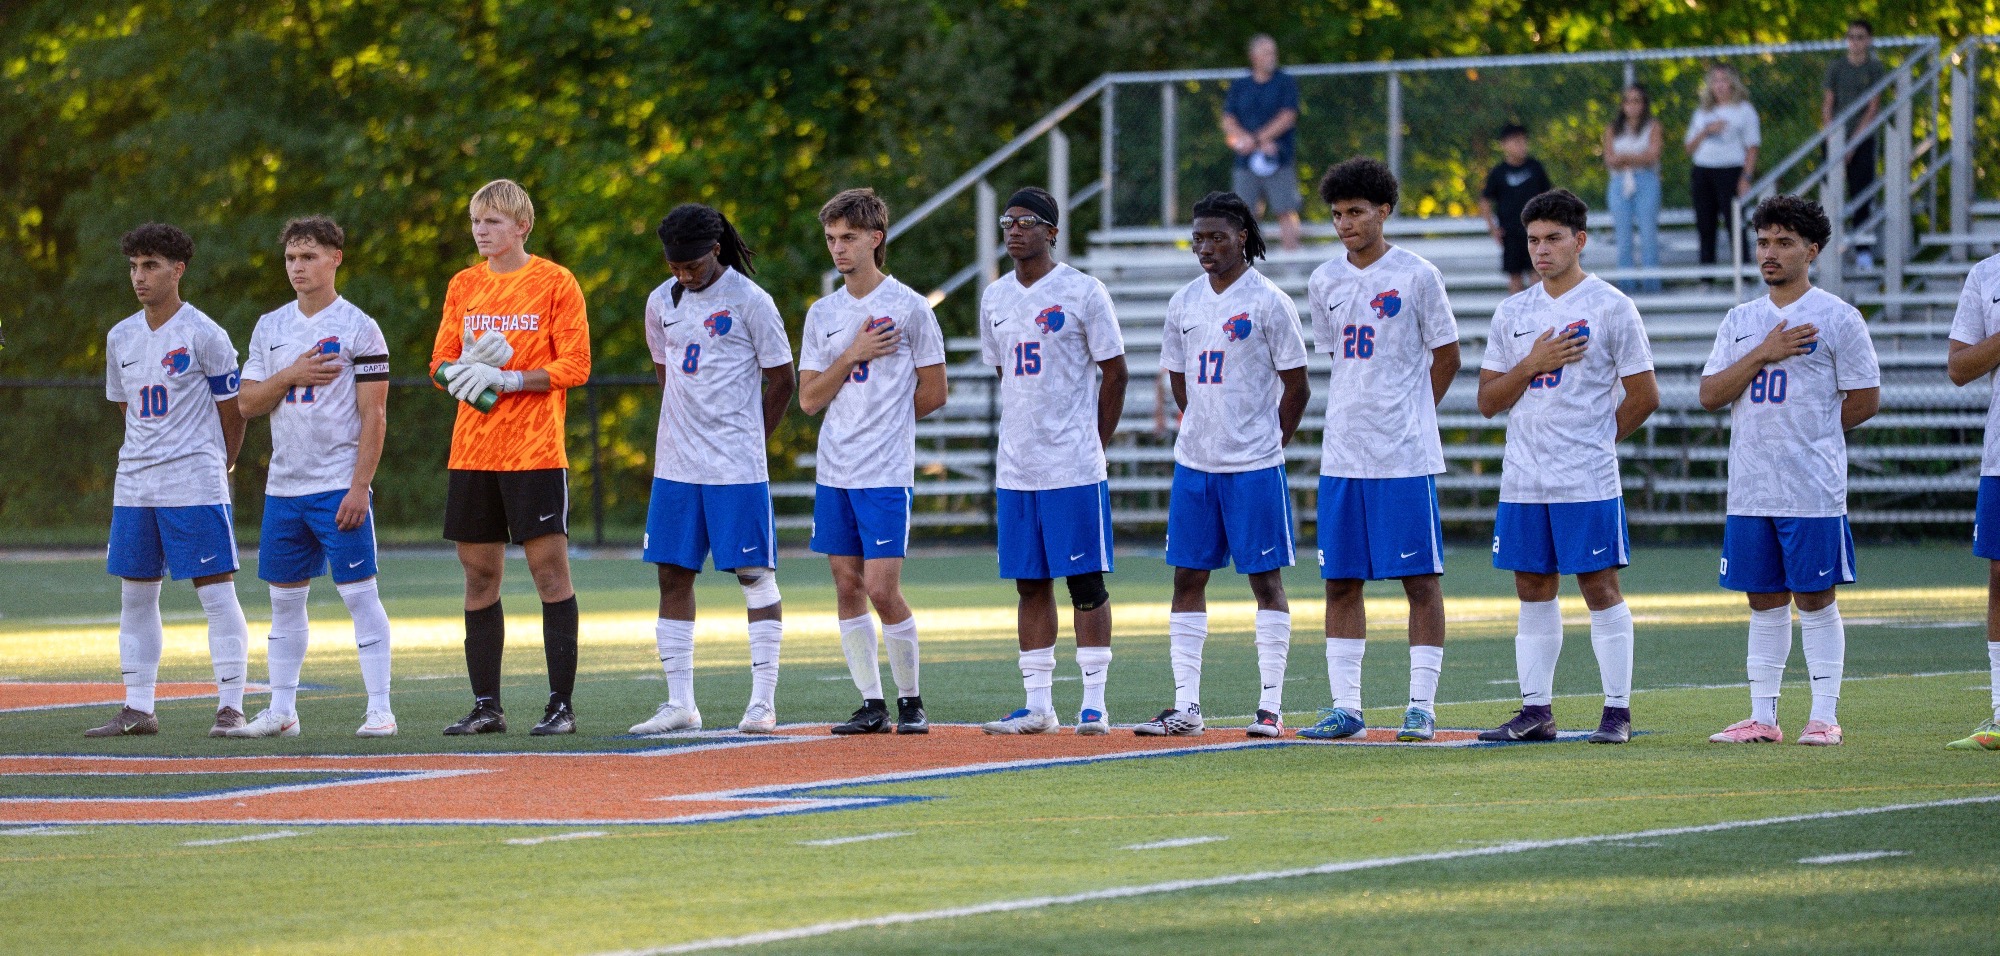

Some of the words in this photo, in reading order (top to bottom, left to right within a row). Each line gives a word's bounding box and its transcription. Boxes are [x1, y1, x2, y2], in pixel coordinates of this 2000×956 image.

[464, 314, 539, 331] PURCHASE
[682, 342, 701, 375] 8
[1014, 341, 1041, 376] 15
[1343, 324, 1375, 360] 26
[226, 373, 239, 392] C
[845, 360, 869, 384] 3
[1197, 350, 1225, 384] 17
[139, 384, 169, 418] 10
[1750, 368, 1787, 404] 80
